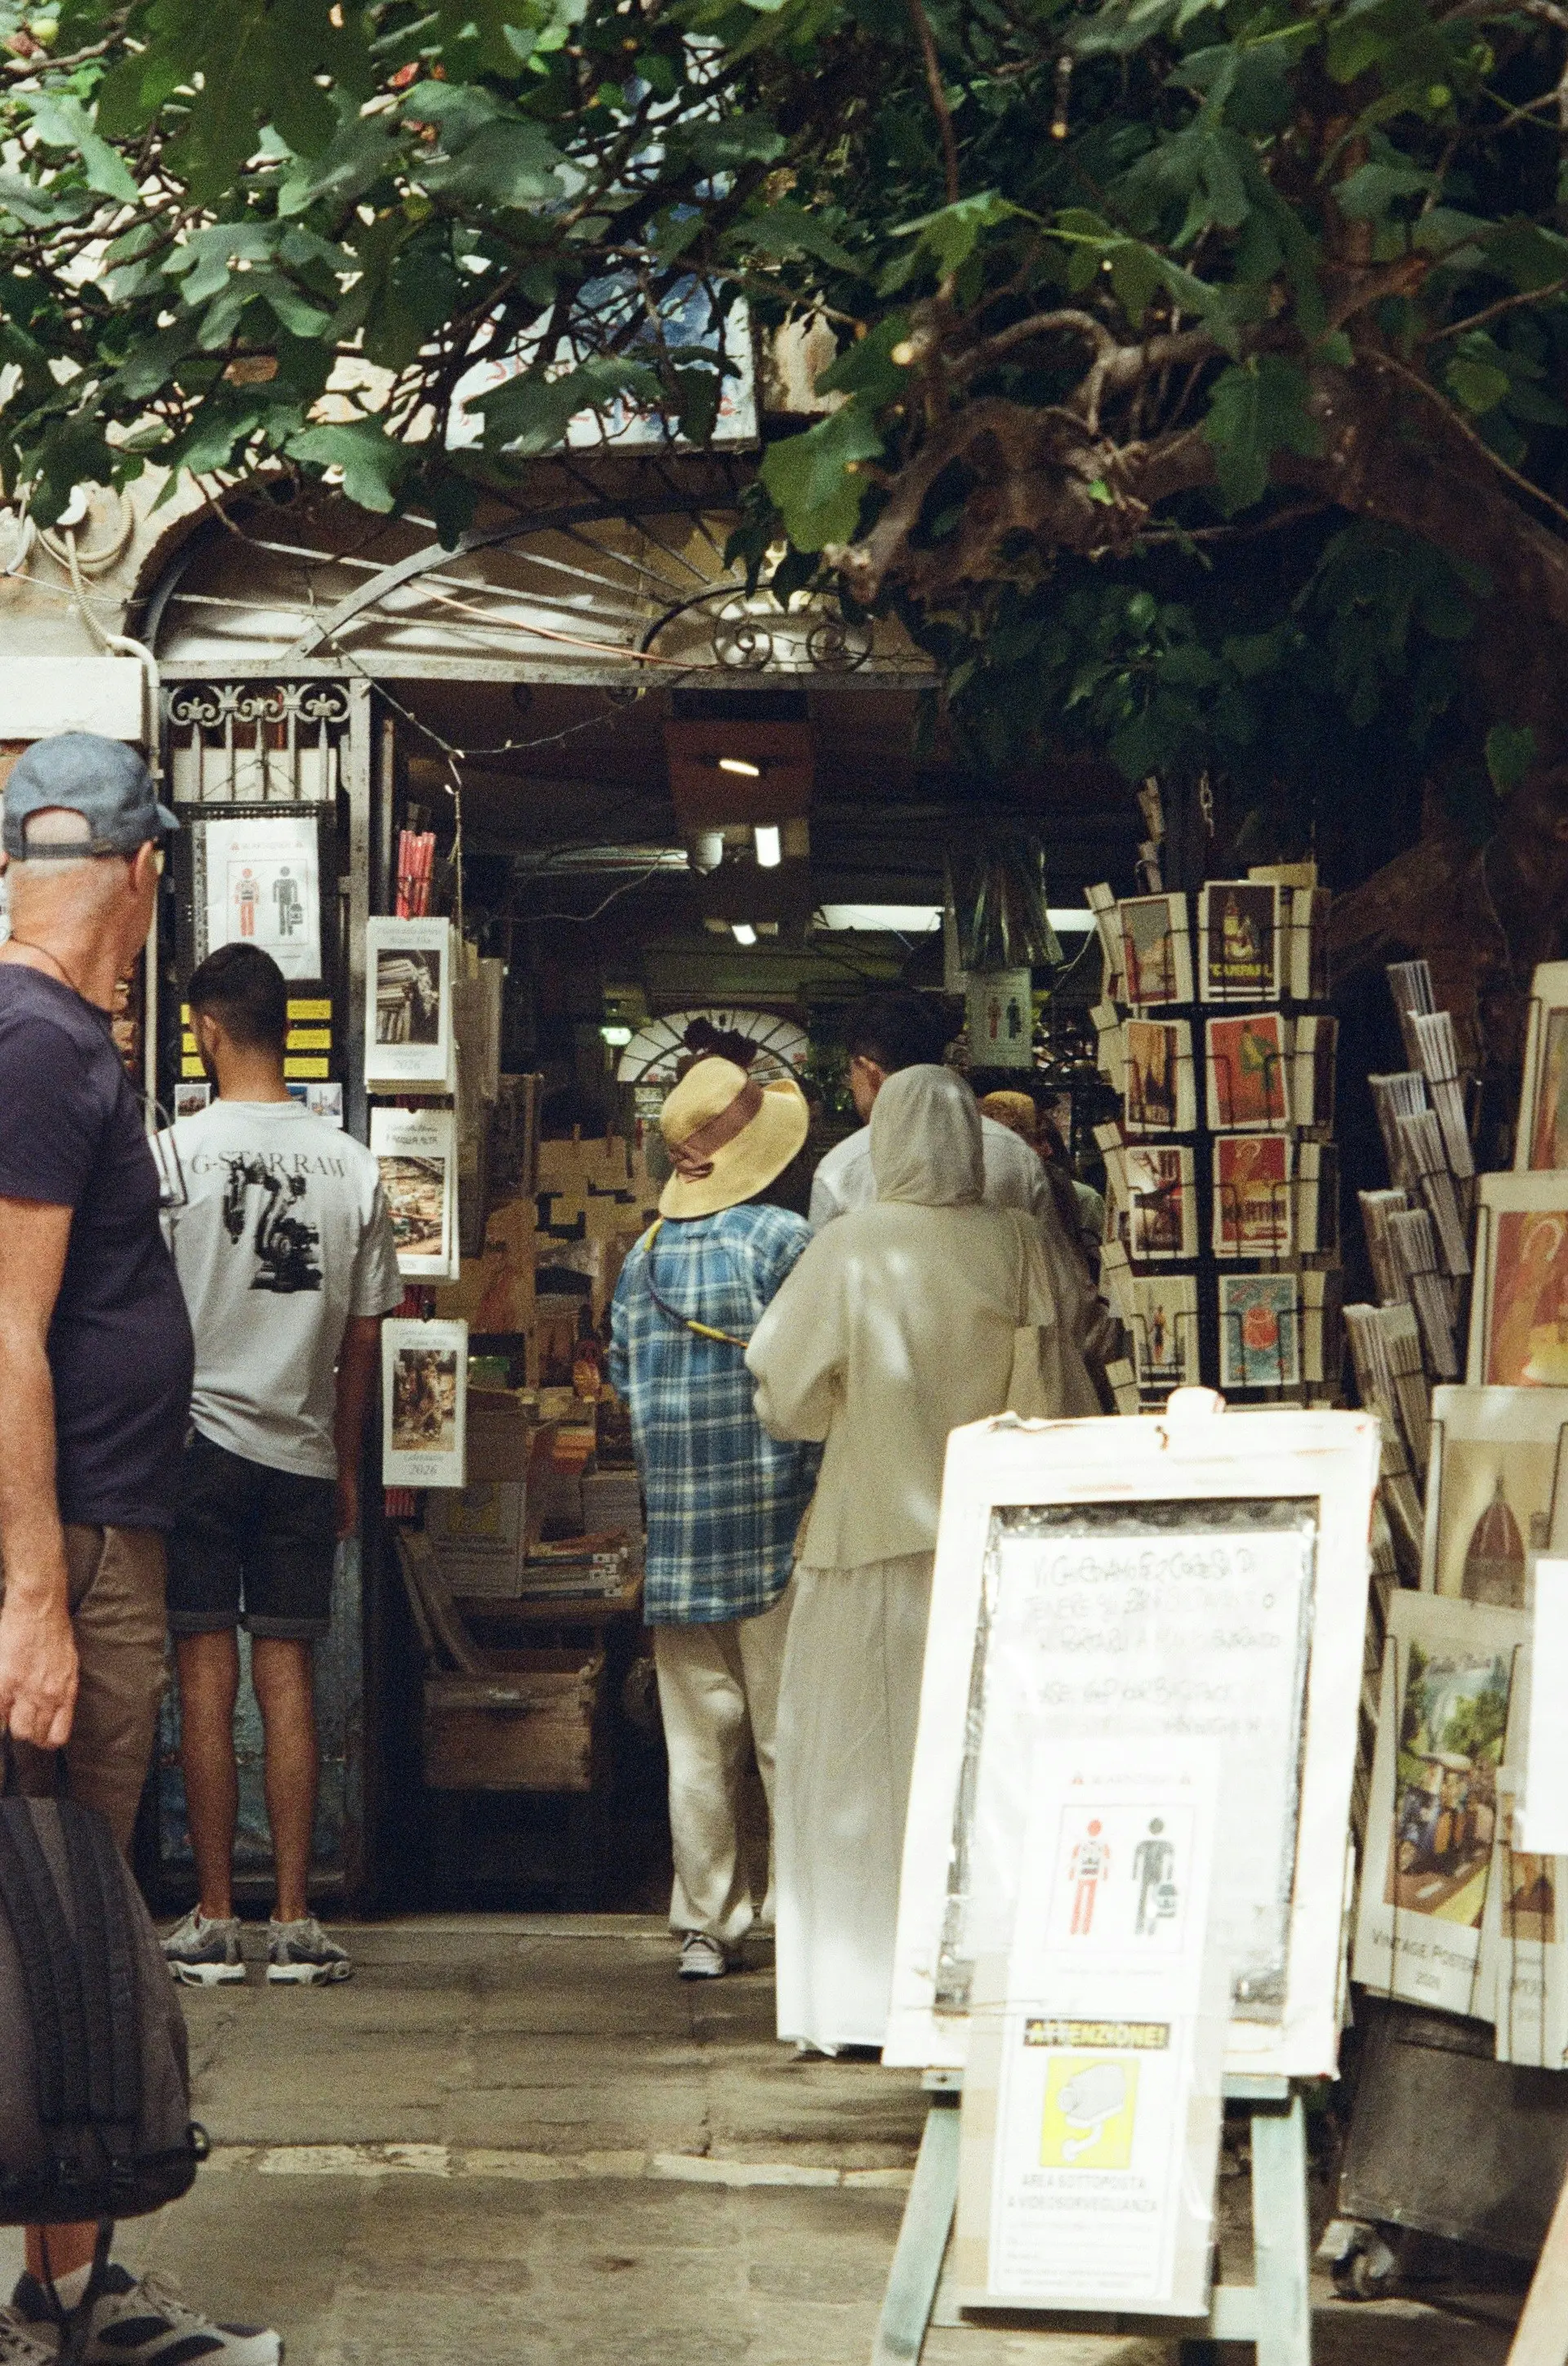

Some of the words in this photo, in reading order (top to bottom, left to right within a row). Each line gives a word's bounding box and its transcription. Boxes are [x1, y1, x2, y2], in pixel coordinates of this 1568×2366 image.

[393, 1060, 421, 1071] 2026
[192, 1150, 283, 1175] G-STAR
[294, 1152, 345, 1177] RAW
[408, 1464, 438, 1476] 2026
[1028, 2022, 1165, 2047] ATTENZIONE!
[1058, 2176, 1147, 2190] SOTTOPOSTA
[1019, 2197, 1158, 2212] VIDEOSORVEGLIANZA
